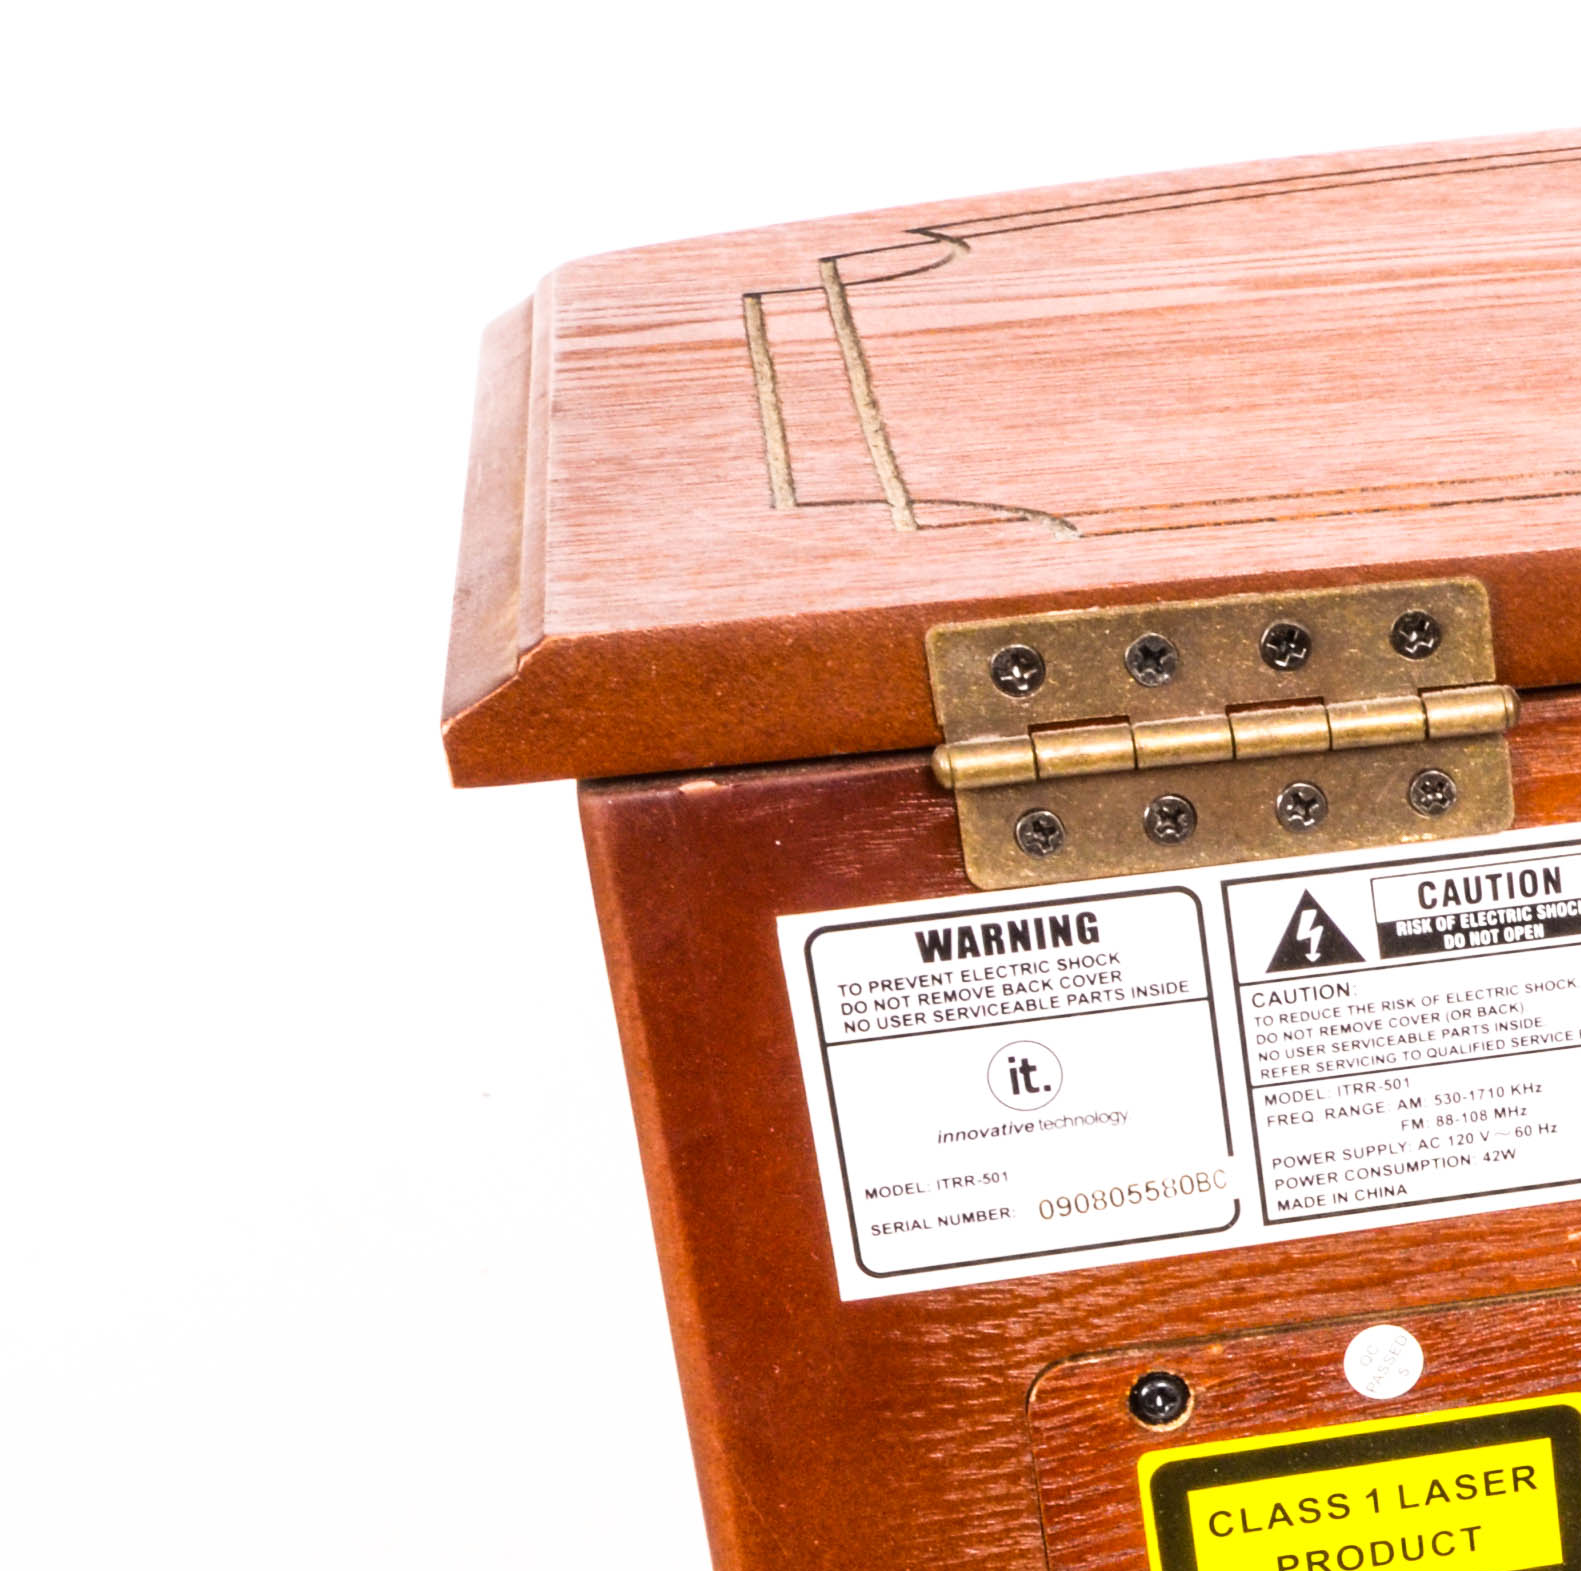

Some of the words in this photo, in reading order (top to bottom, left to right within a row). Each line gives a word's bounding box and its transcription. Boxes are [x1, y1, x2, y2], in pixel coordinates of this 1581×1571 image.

[1417, 866, 1562, 910] CAUTION
[914, 911, 1100, 964] WARNING
[1396, 916, 1432, 937] RISK
[1437, 915, 1456, 933] OF
[1461, 907, 1532, 929] ELECTRIC
[1443, 932, 1466, 950] DO
[1468, 927, 1500, 947] NOT
[1503, 922, 1545, 943] OPEN
[837, 982, 863, 997] TO
[868, 971, 953, 994] PREVENT
[960, 960, 1050, 983] ELECTRIC
[1056, 952, 1121, 972] SHOCK
[840, 1000, 868, 1016] DO
[873, 995, 911, 1011] NOT
[917, 985, 996, 1006] REMOVE
[1002, 979, 1054, 997] BACK
[1059, 970, 1122, 990] COVER
[843, 1018, 871, 1033] NO
[876, 1012, 927, 1030] USER
[932, 995, 1060, 1023] SERVICEABLE
[1066, 988, 1125, 1006] PARTS
[1131, 980, 1189, 999] INSIDE
[1254, 1015, 1274, 1027] TO
[1278, 1006, 1341, 1024] REDUCE
[1347, 1002, 1376, 1015] THE
[1381, 998, 1416, 1011] RISK
[1421, 994, 1440, 1007] OF
[1446, 984, 1519, 1004] ELECTRIC
[1260, 1063, 1311, 1080] REFER
[1315, 1052, 1397, 1073] SERVICING
[1426, 1039, 1506, 1059] QUALIFIED
[1510, 1030, 1574, 1048] SERVICE
[1434, 1086, 1505, 1106] 530-1710
[1510, 1082, 1542, 1096] KHz
[937, 1121, 1035, 1144] innovative
[1038, 1111, 1128, 1131] technology
[1436, 1109, 1488, 1128] 88-108
[1493, 1105, 1527, 1119] MHz
[1272, 1150, 1337, 1170] POWER
[1417, 1136, 1440, 1151] AC
[1448, 1132, 1474, 1146] 120
[1514, 1124, 1533, 1138] 60
[1538, 1122, 1557, 1135] Hz
[1274, 1171, 1338, 1191] POWER
[1483, 1148, 1516, 1162] 42W
[1277, 1194, 1326, 1211] MADE
[1332, 1191, 1349, 1204] IN
[1354, 1184, 1408, 1202] CHINA
[870, 1219, 931, 1237] SERIAL
[1208, 1493, 1351, 1538] CLASS
[1365, 1487, 1380, 1514] 1
[1397, 1465, 1537, 1510] LASER
